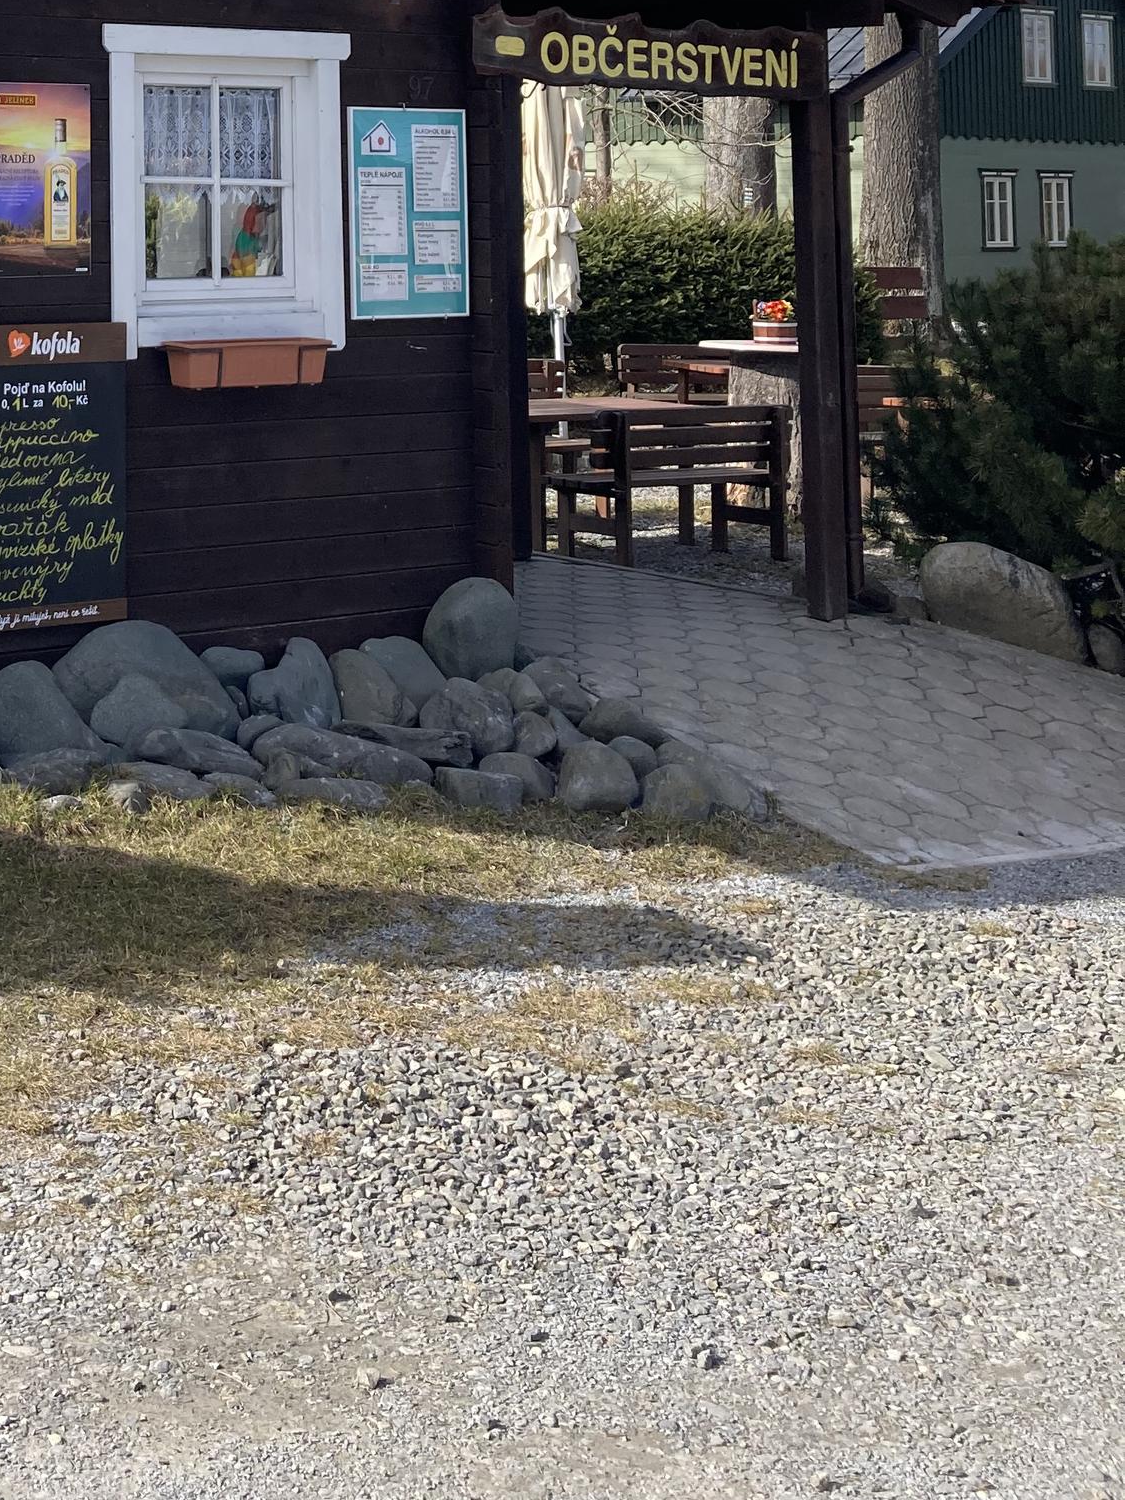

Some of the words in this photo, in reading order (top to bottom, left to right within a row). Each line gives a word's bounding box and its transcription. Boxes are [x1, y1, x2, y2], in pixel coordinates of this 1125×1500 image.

[540, 24, 798, 88] OBČERSTVENÍ
[31, 331, 81, 361] kofola
[3, 382, 30, 397] Pojď
[32, 384, 45, 393] na
[48, 380, 86, 393] Kofolu!
[33, 398, 44, 408] za
[76, 394, 89, 405] Kč
[65, 517, 124, 565] oplatky
[10, 613, 20, 628] ji
[53, 607, 69, 620] není
[71, 609, 80, 617] co
